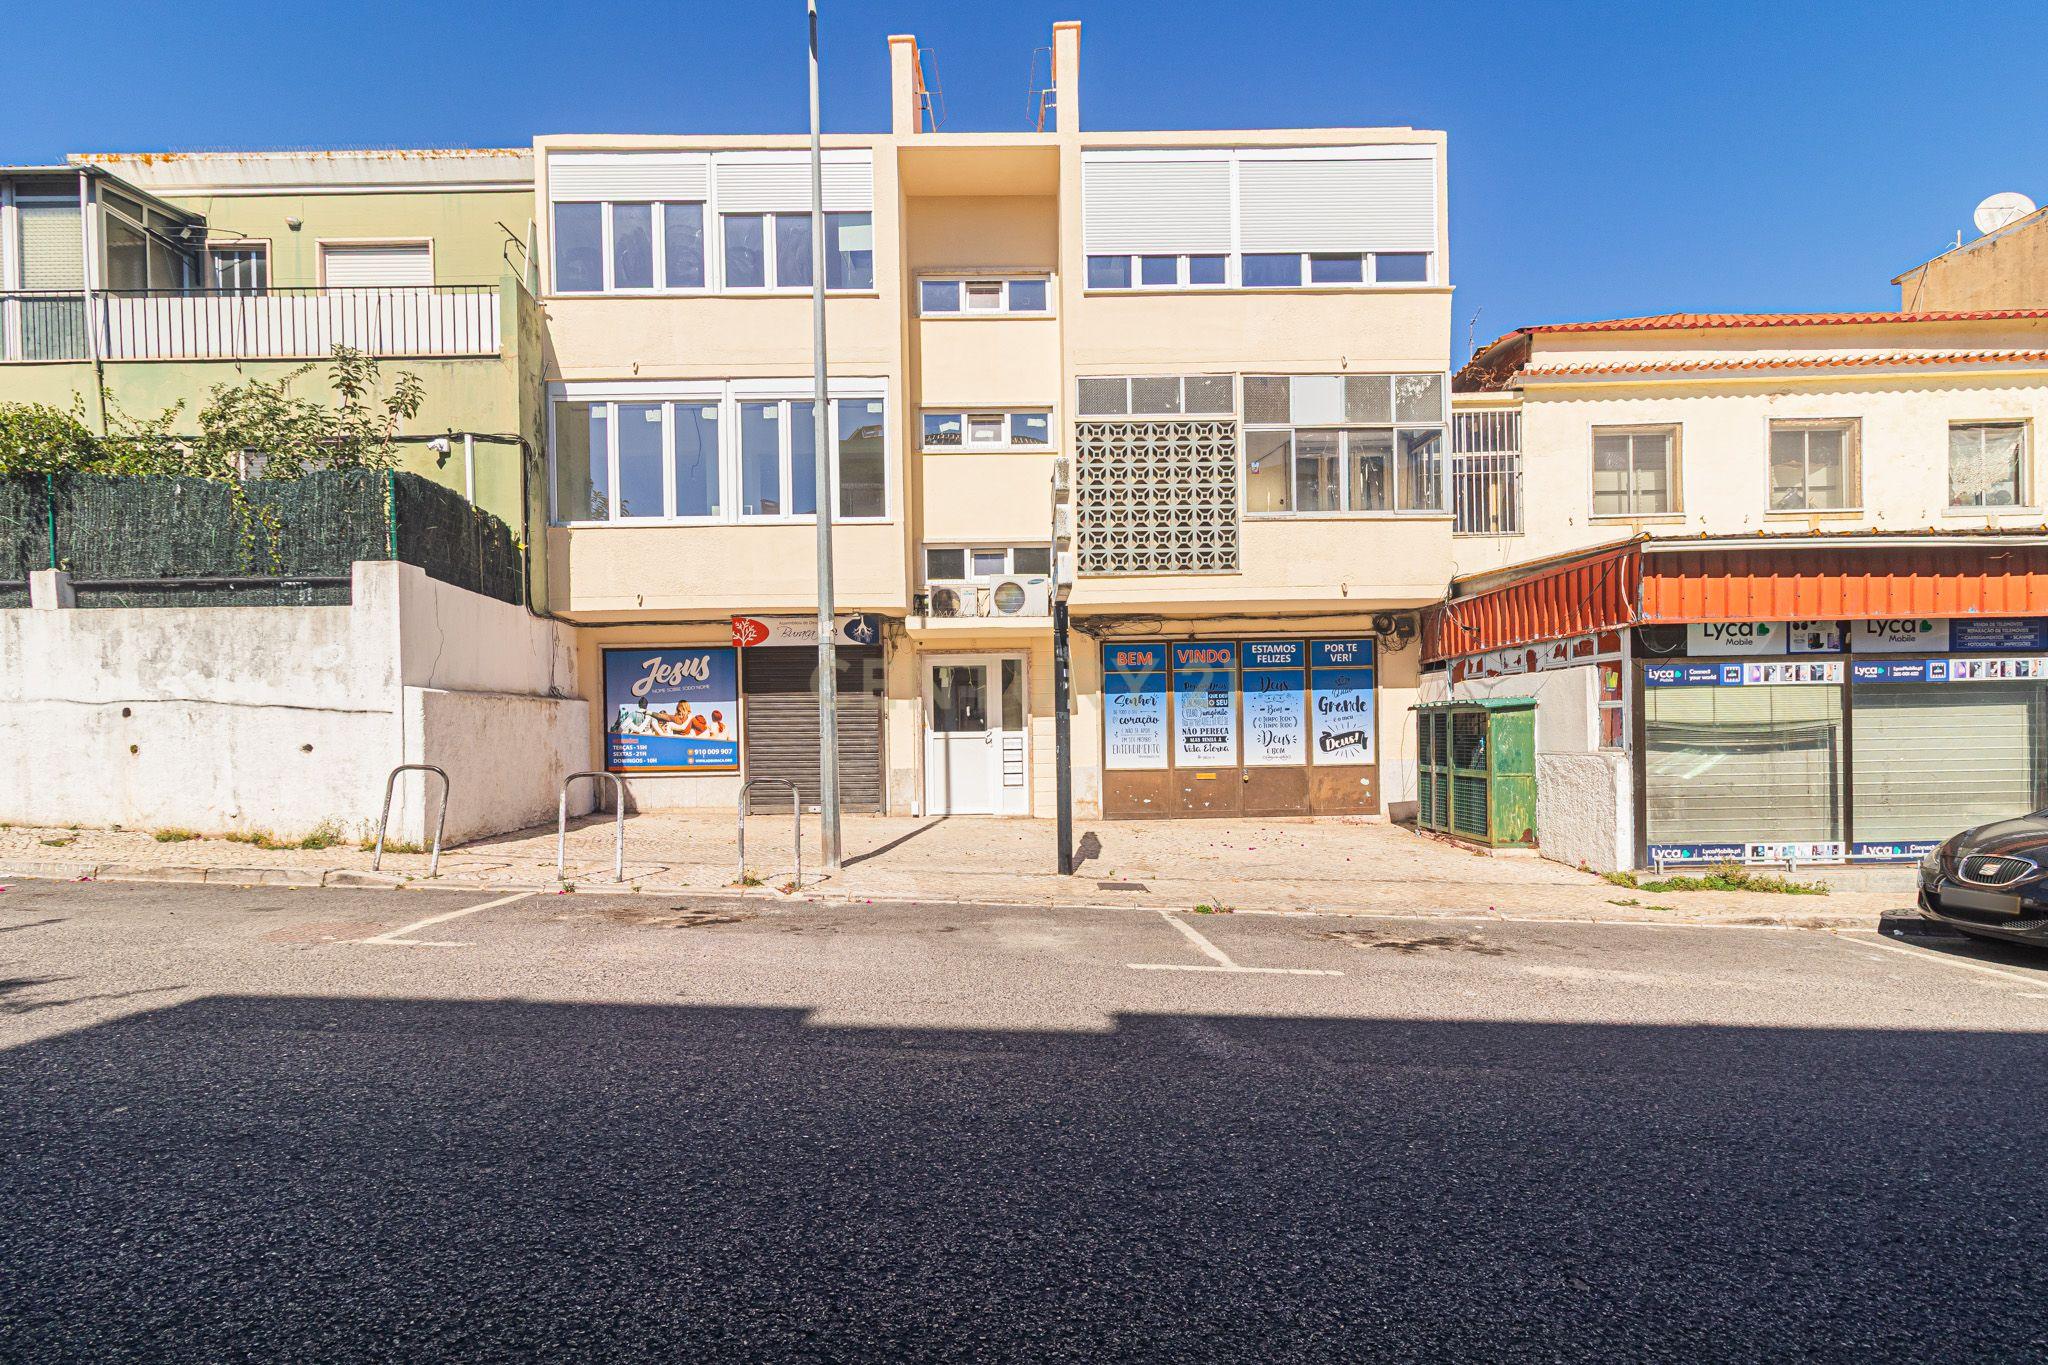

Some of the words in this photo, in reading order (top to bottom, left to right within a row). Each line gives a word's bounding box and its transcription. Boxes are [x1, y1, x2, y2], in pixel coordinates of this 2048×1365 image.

[1704, 622, 1753, 640] Lyca
[1867, 620, 1915, 637] Lyca
[1325, 644, 1344, 652] POR
[1347, 643, 1358, 652] TE
[1726, 638, 1753, 646] Mobile
[1251, 644, 1296, 654] ESTAMOS
[1117, 651, 1153, 666] BEM
[1177, 649, 1230, 664] VINDO
[1257, 654, 1291, 663] FELIZES
[1330, 653, 1352, 662] VER!
[631, 655, 710, 697] Jesus
[1648, 669, 1674, 680] Lyca
[1854, 666, 1878, 676] Lyca
[1259, 676, 1289, 693] Deus
[1114, 694, 1157, 707] Senhor
[1318, 695, 1367, 715] Grande
[1119, 715, 1159, 726] coração
[1182, 727, 1197, 736] NÃO
[1262, 730, 1291, 748] Deus
[1325, 732, 1360, 751] Deus!
[694, 748, 707, 756] 910
[1184, 744, 1201, 753] Vida
[1203, 743, 1230, 753] Eterna
